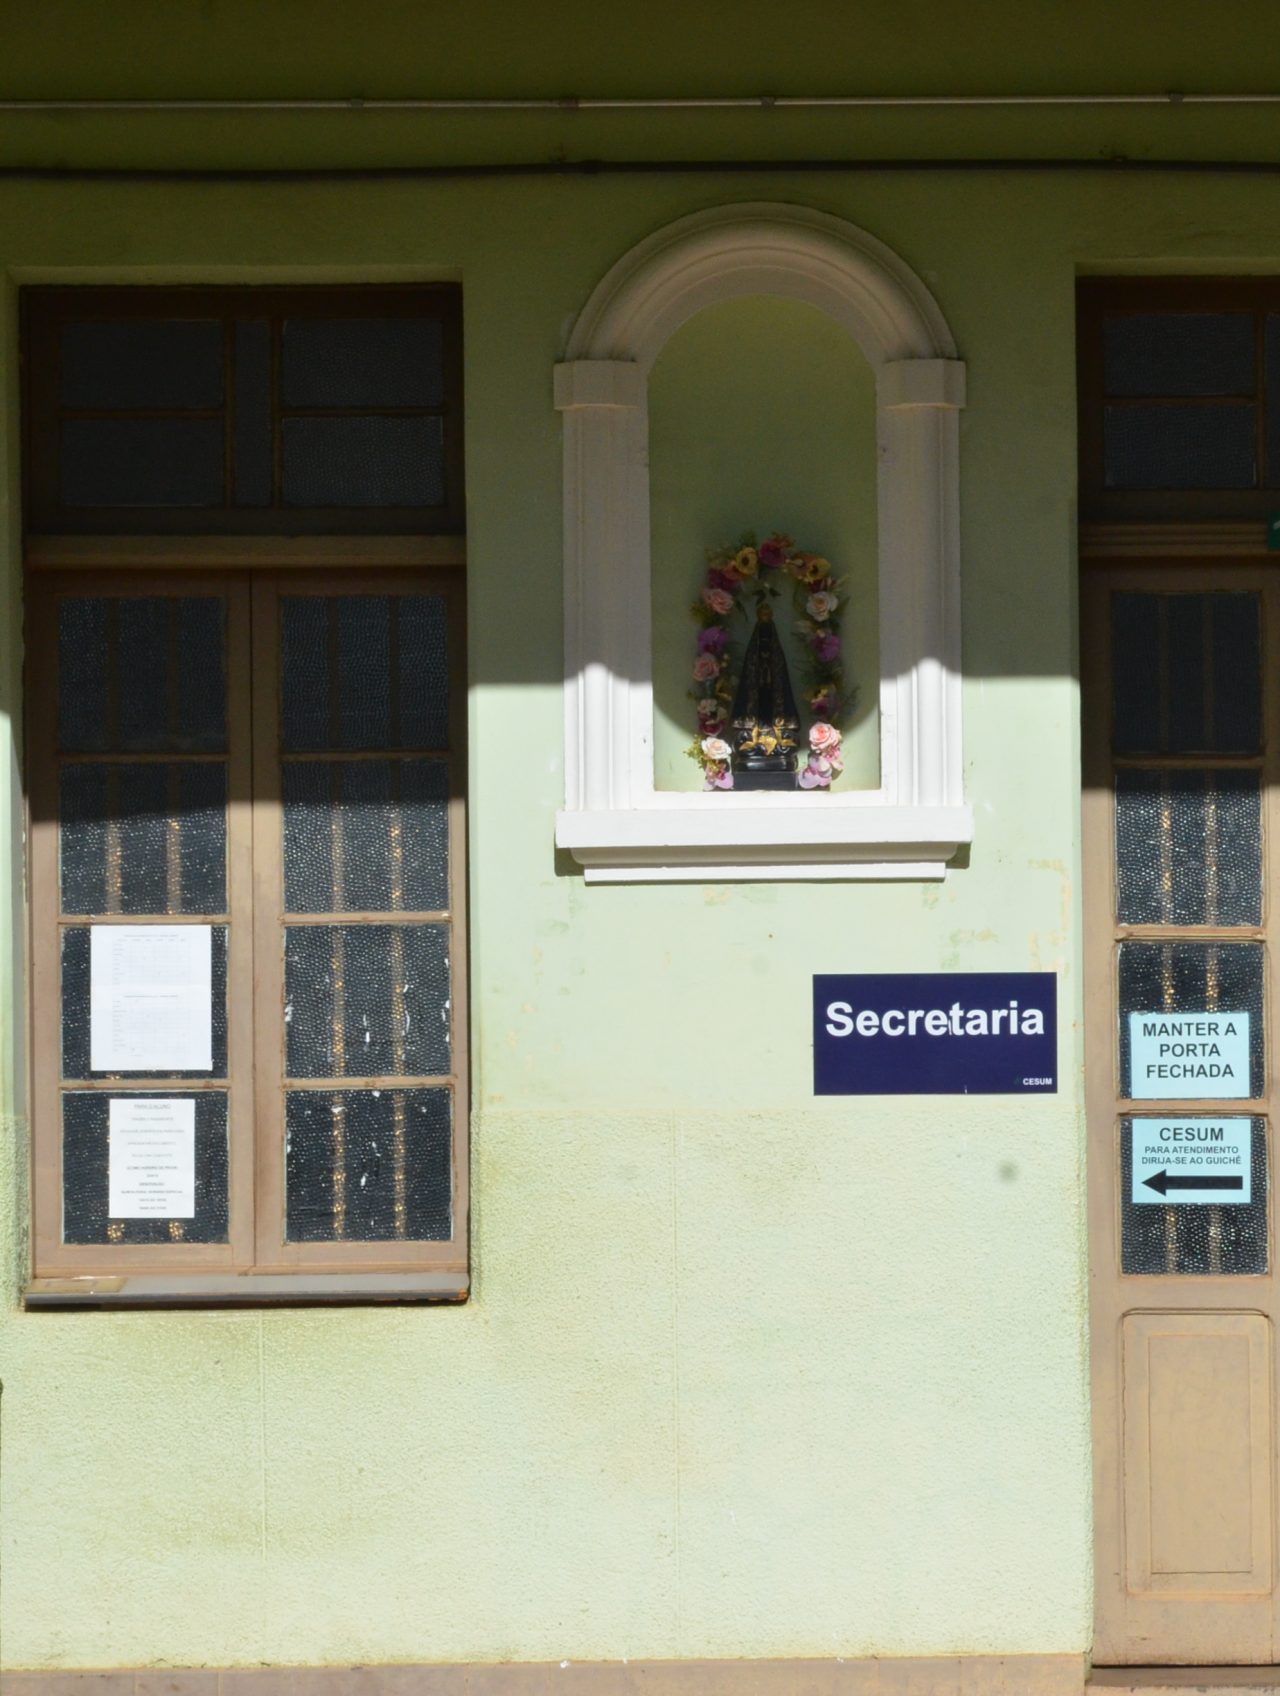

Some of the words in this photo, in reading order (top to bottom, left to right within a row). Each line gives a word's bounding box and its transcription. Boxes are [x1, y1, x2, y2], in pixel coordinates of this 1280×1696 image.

[825, 1001, 1044, 1037] Secretaria
[1143, 1022, 1219, 1036] MANTER
[1224, 1022, 1237, 1036] A
[1160, 1043, 1220, 1057] PORTA
[1147, 1064, 1234, 1078] FECHADA
[1160, 1127, 1224, 1141] CESUM
[1145, 1146, 1170, 1154] PARA
[1172, 1146, 1239, 1154] ATENDIMENTO
[1142, 1157, 1187, 1165] DIRIJA-SE
[1190, 1157, 1204, 1165] AO
